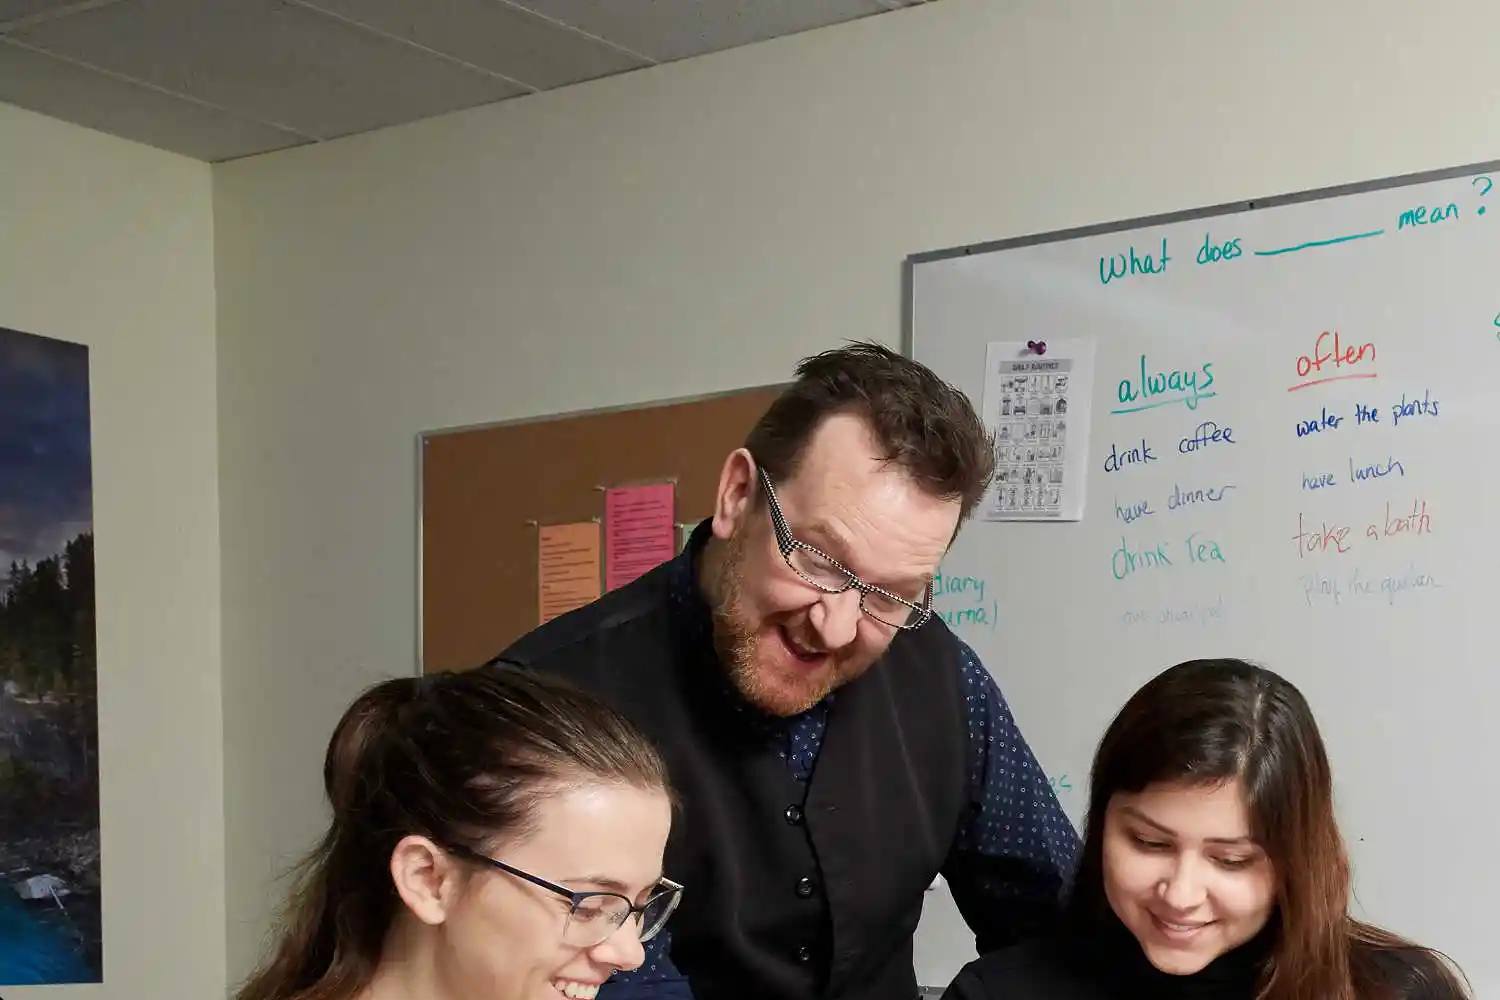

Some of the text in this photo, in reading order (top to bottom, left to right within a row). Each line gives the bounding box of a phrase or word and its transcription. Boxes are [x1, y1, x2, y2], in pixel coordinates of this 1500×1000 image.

[1100, 176, 1492, 284] What does mean ?
[1296, 331, 1376, 377] often
[1118, 354, 1213, 410] always
[1296, 388, 1441, 438] water the plants
[1104, 421, 1236, 473] drink coffee
[1302, 455, 1405, 491] have lunch
[1114, 484, 1237, 523] have dinner
[1292, 498, 1431, 559] take a bath
[1112, 536, 1172, 580] drink
